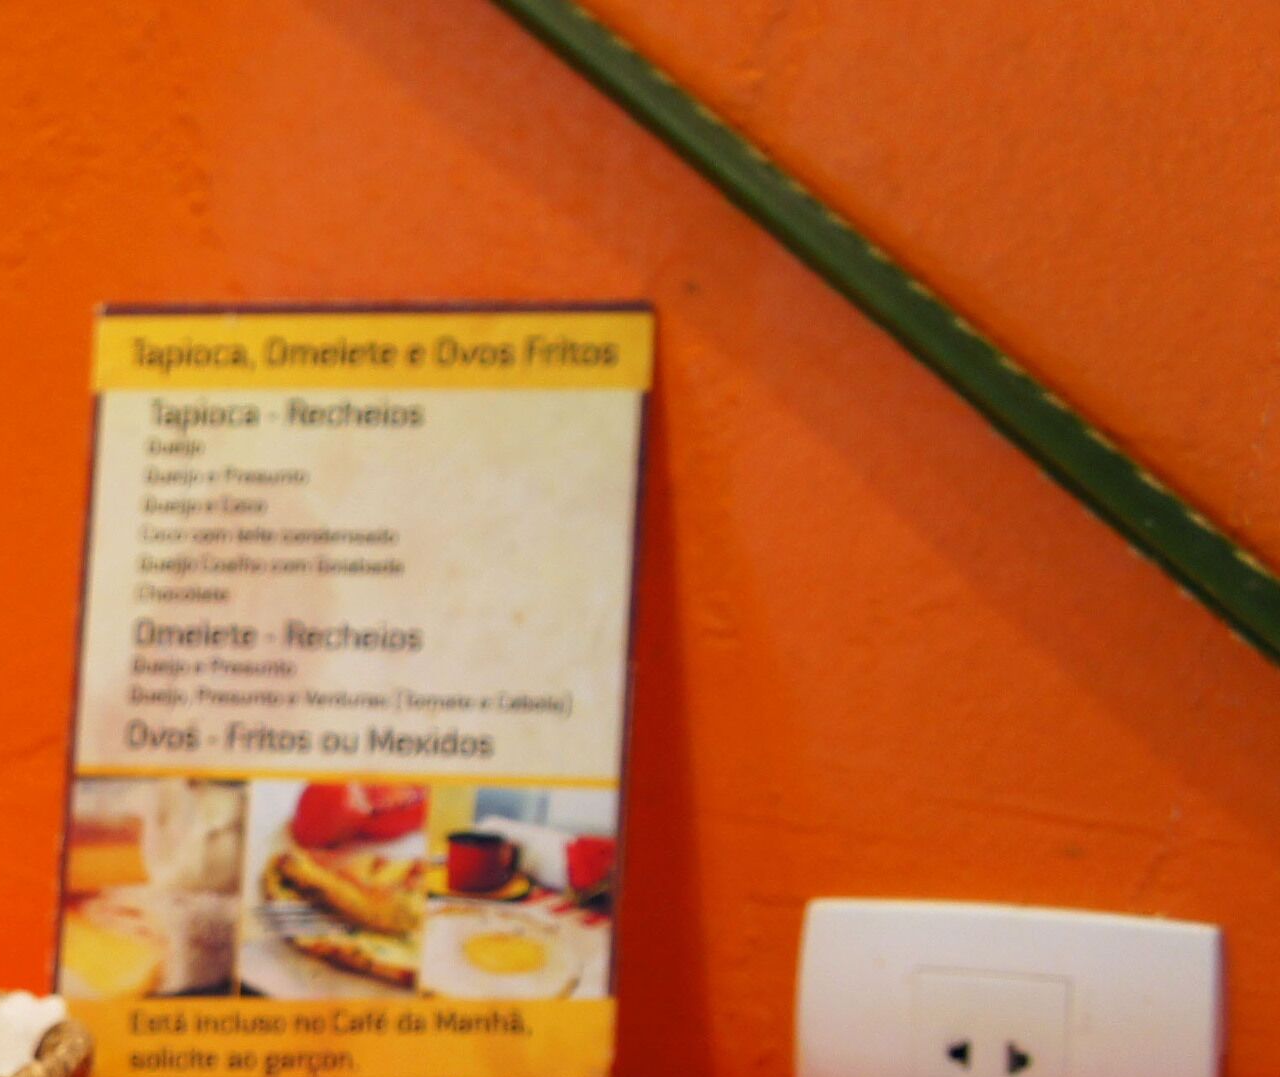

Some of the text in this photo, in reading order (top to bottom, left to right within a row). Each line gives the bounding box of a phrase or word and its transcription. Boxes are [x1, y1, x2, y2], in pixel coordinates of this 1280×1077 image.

[132, 334, 619, 377] Tapioca, Omelete e Ovos Fritos
[151, 398, 261, 433] Tapioca
[287, 398, 424, 428] Recheios
[134, 618, 257, 648] Omelete
[284, 618, 423, 650] Recheios
[126, 719, 200, 750] Ovos
[225, 720, 312, 752] Fritos
[320, 729, 359, 752] ou
[369, 727, 495, 757] Mexidos
[130, 1010, 188, 1035] Está
[196, 1009, 287, 1035] incluso
[296, 1014, 325, 1034] no
[333, 1007, 388, 1034] Café
[397, 1009, 427, 1034] da
[129, 1046, 218, 1070] solicite
[228, 1051, 257, 1070] ao
